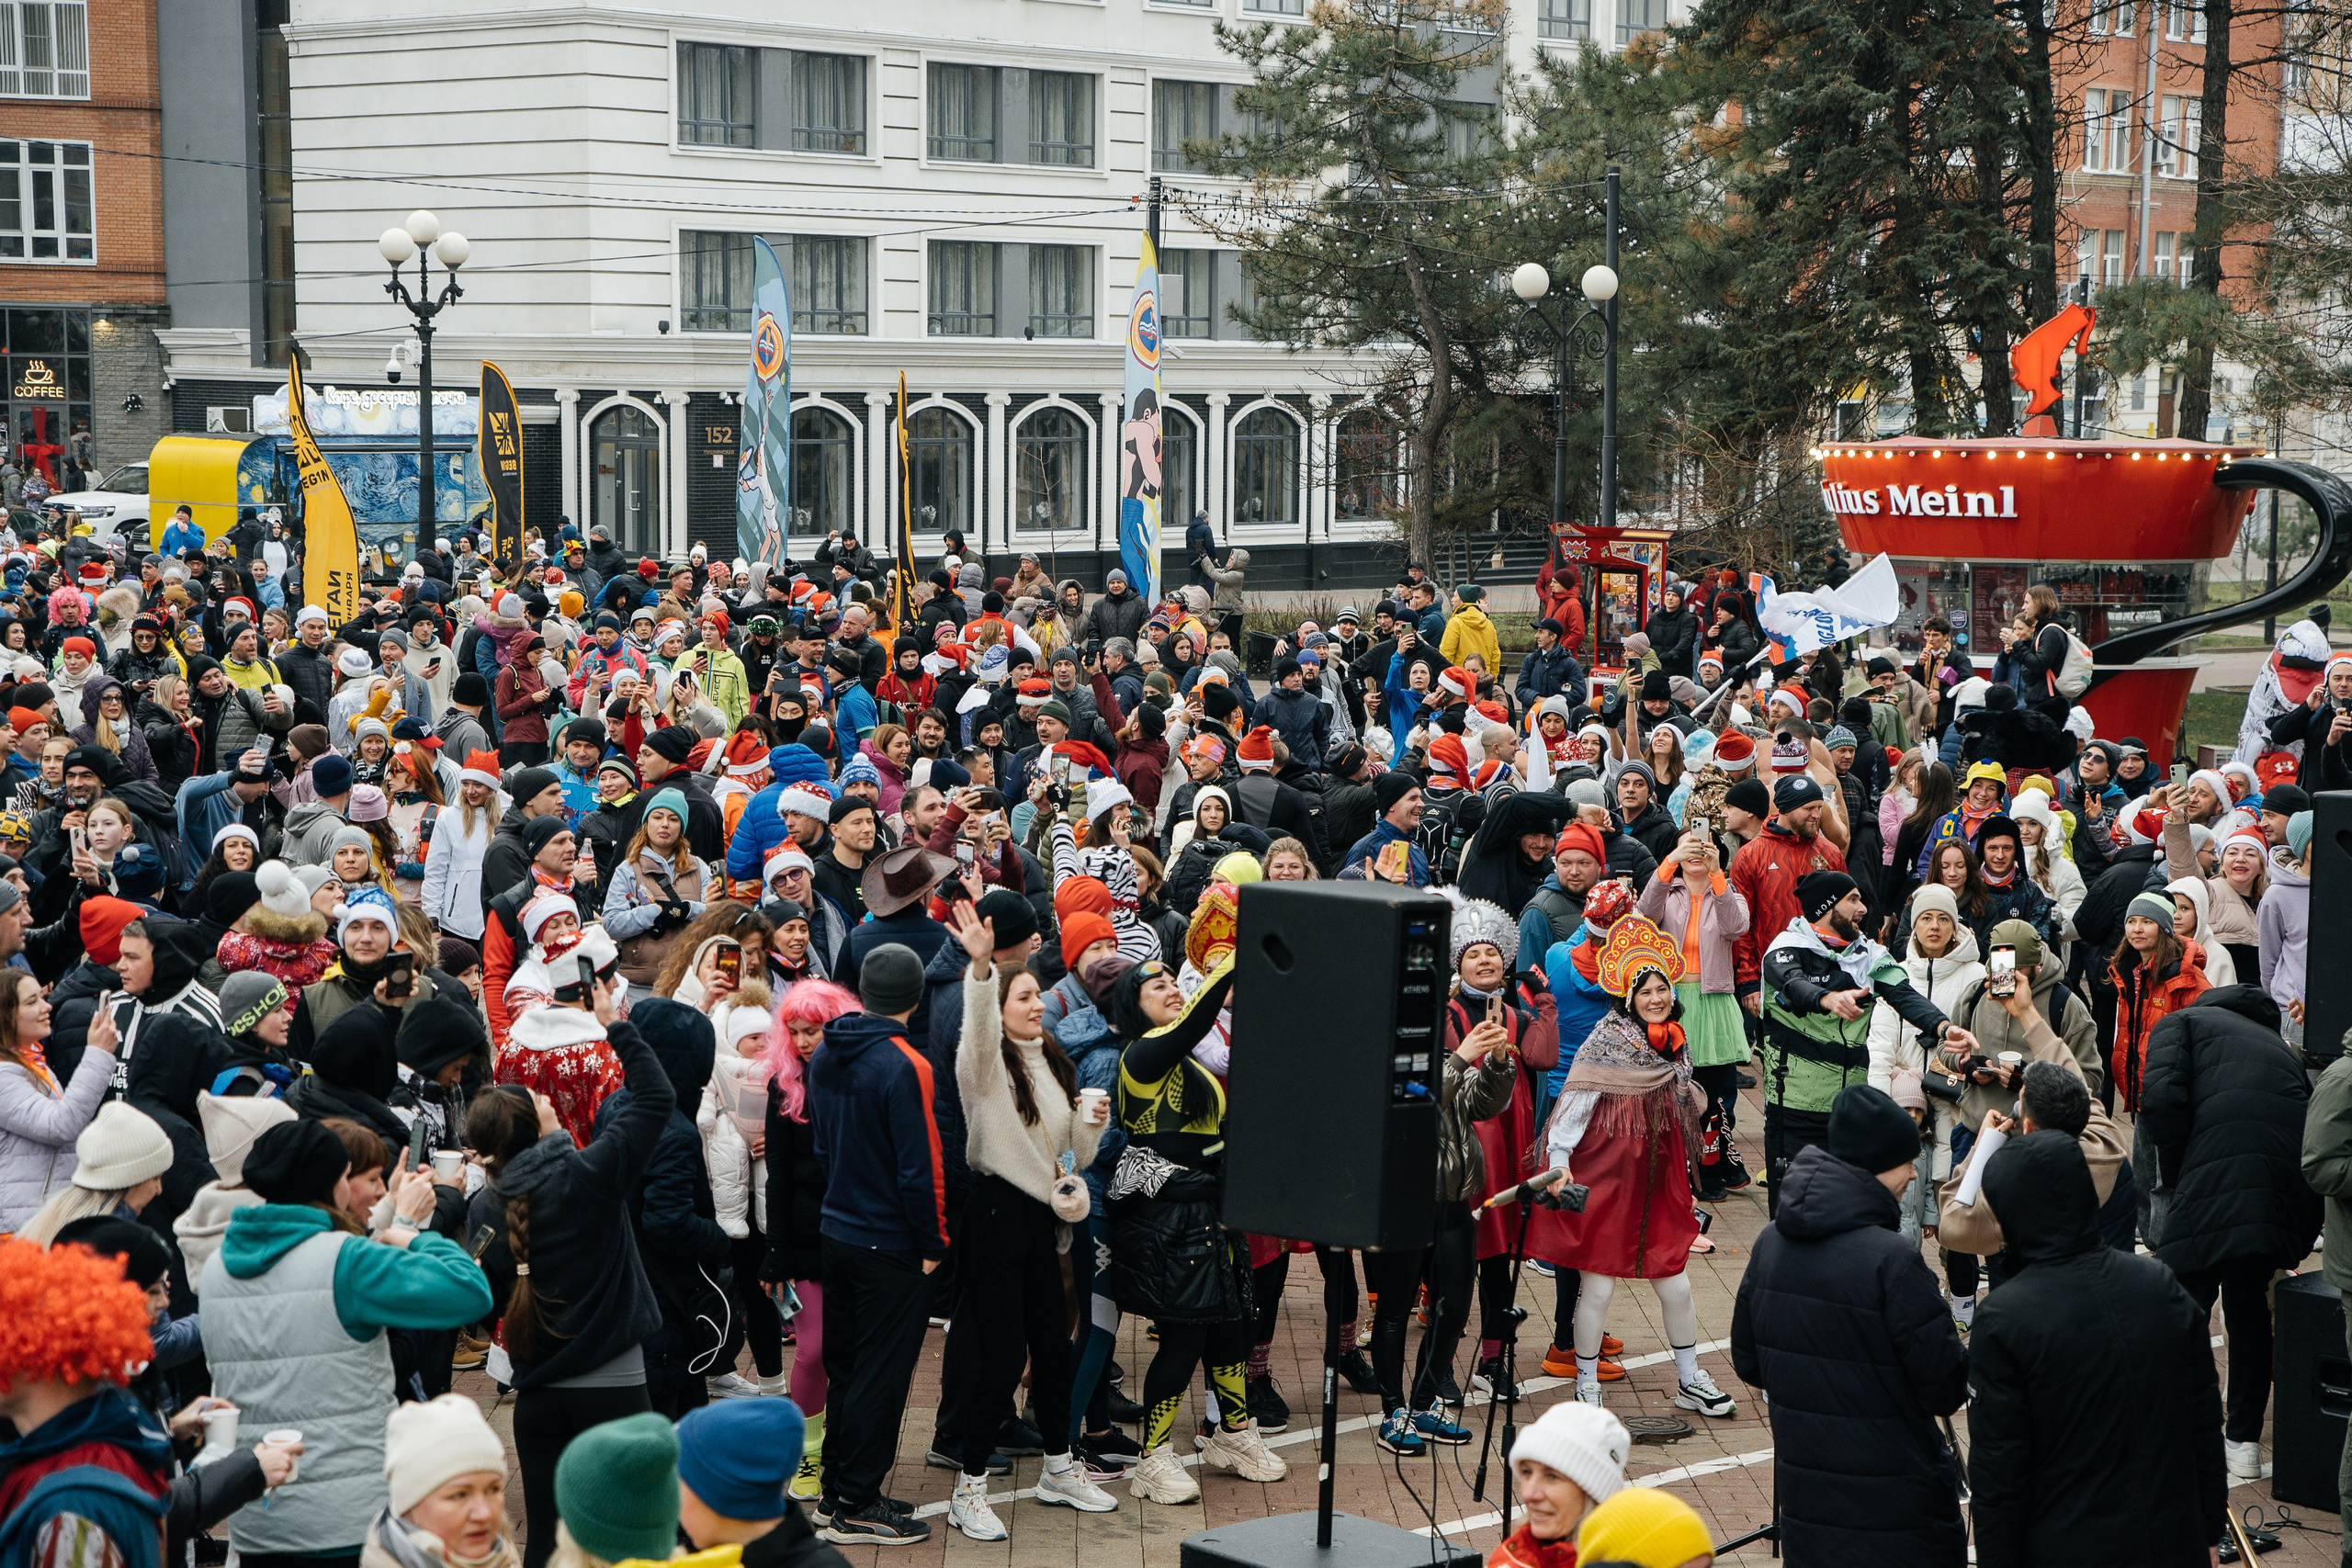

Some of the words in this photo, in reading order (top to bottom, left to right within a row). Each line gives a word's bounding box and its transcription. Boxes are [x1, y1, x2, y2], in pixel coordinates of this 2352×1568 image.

[15, 386, 64, 398] COFFEE
[705, 426, 733, 444] 152
[1820, 482, 1880, 514] ulius
[1885, 484, 2018, 518] Meinl
[1814, 894, 1838, 918] MOAX
